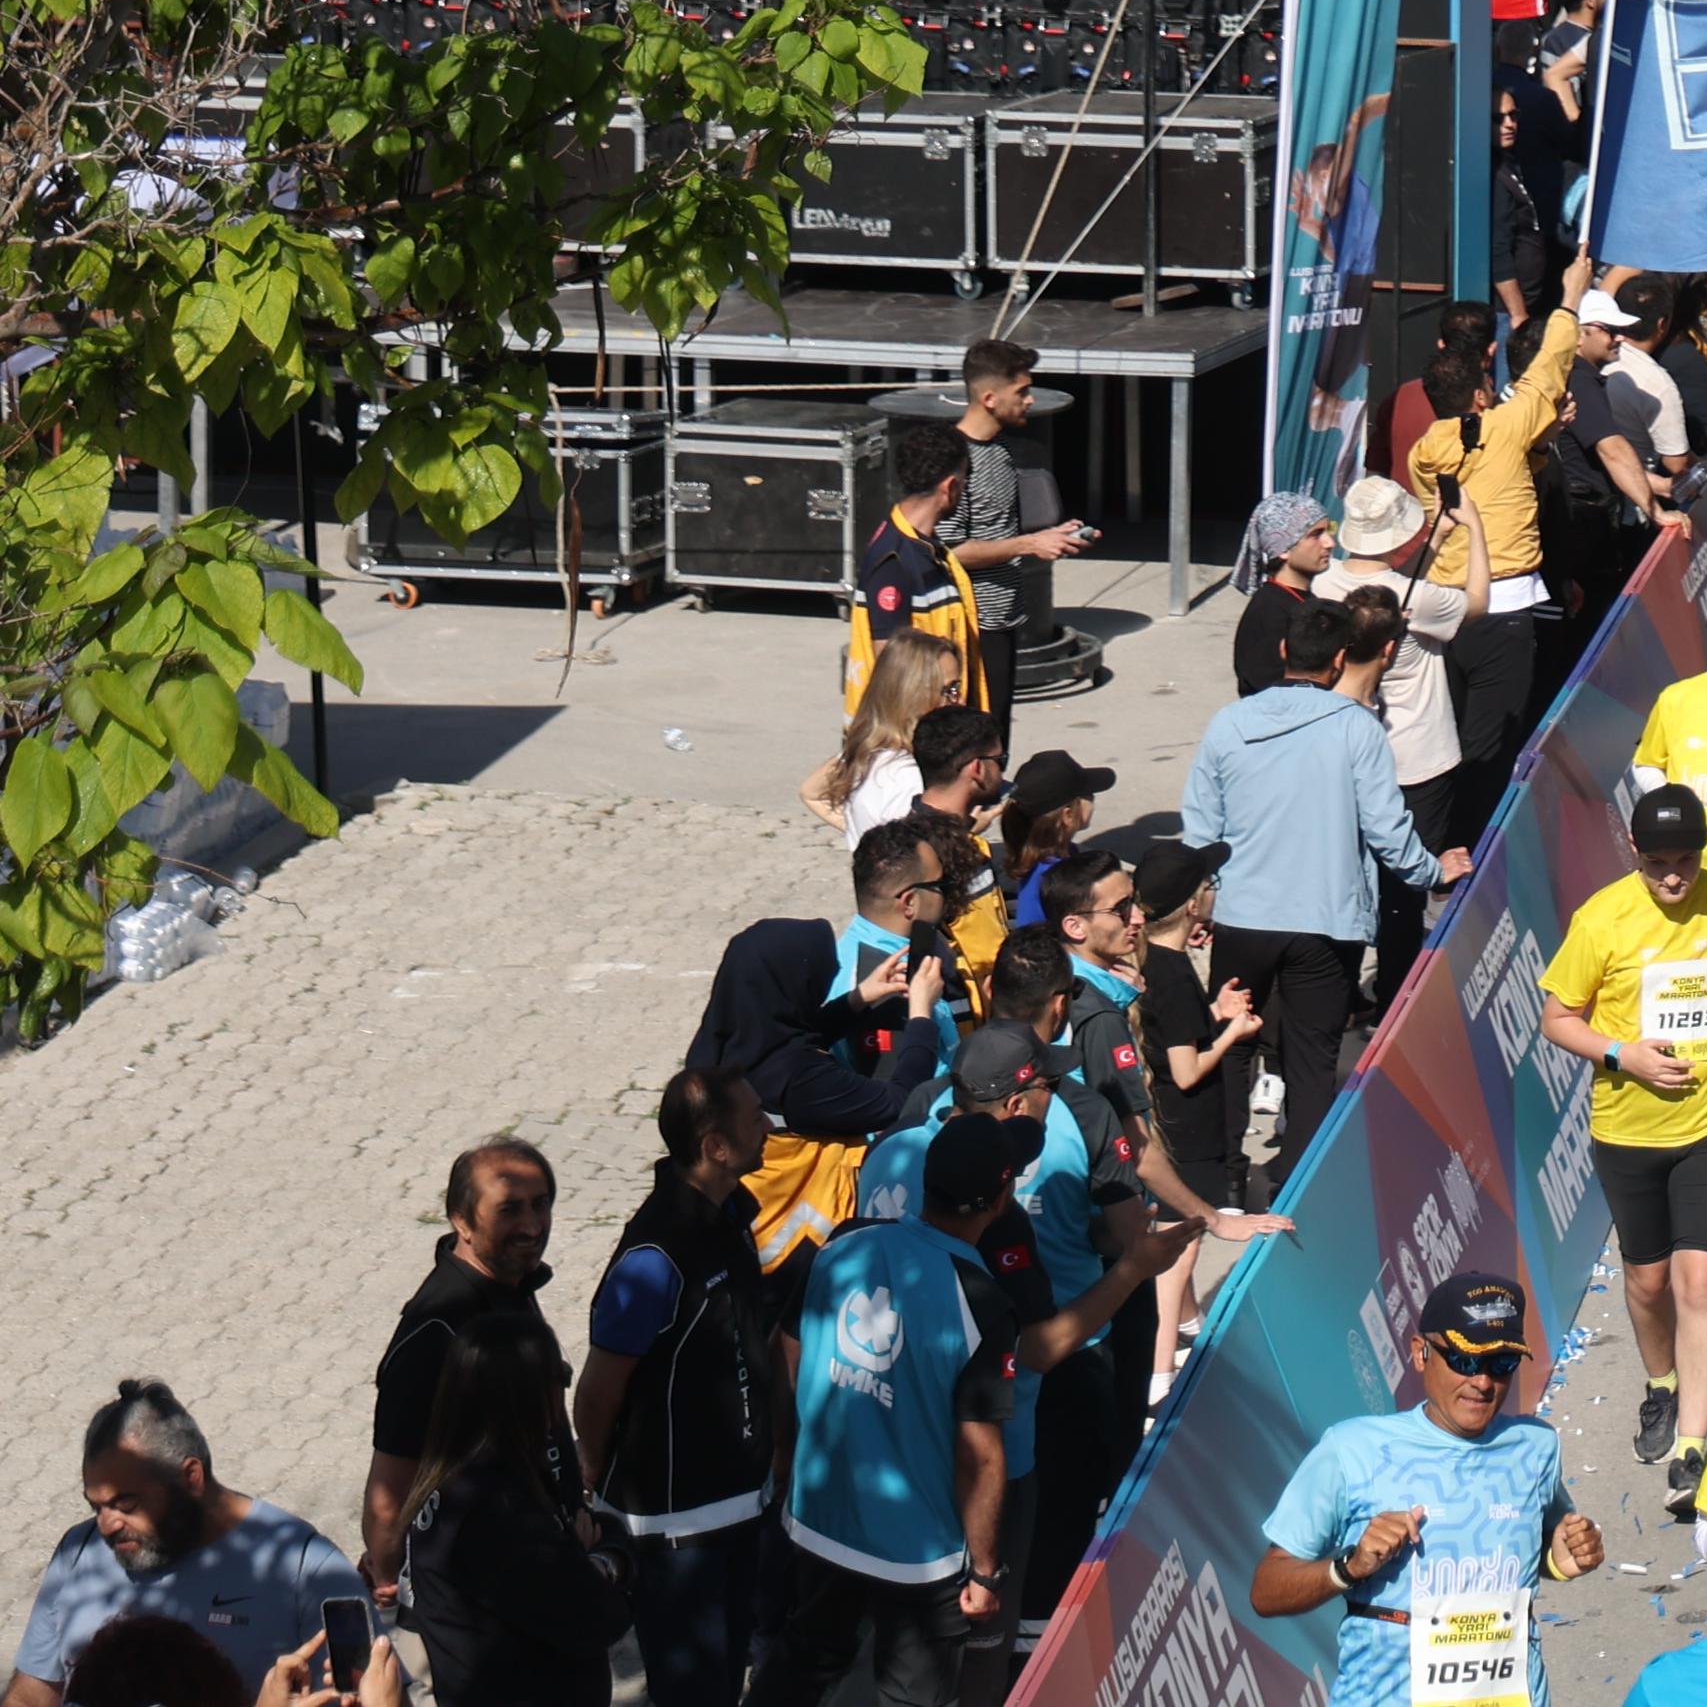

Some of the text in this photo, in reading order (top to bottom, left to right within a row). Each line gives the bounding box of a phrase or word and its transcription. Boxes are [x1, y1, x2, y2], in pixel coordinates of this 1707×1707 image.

[829, 1357, 894, 1409] UMKE
[1448, 1613, 1497, 1626] KONYA
[1433, 1630, 1512, 1646] MARATONU
[1426, 1657, 1515, 1685] 10546
